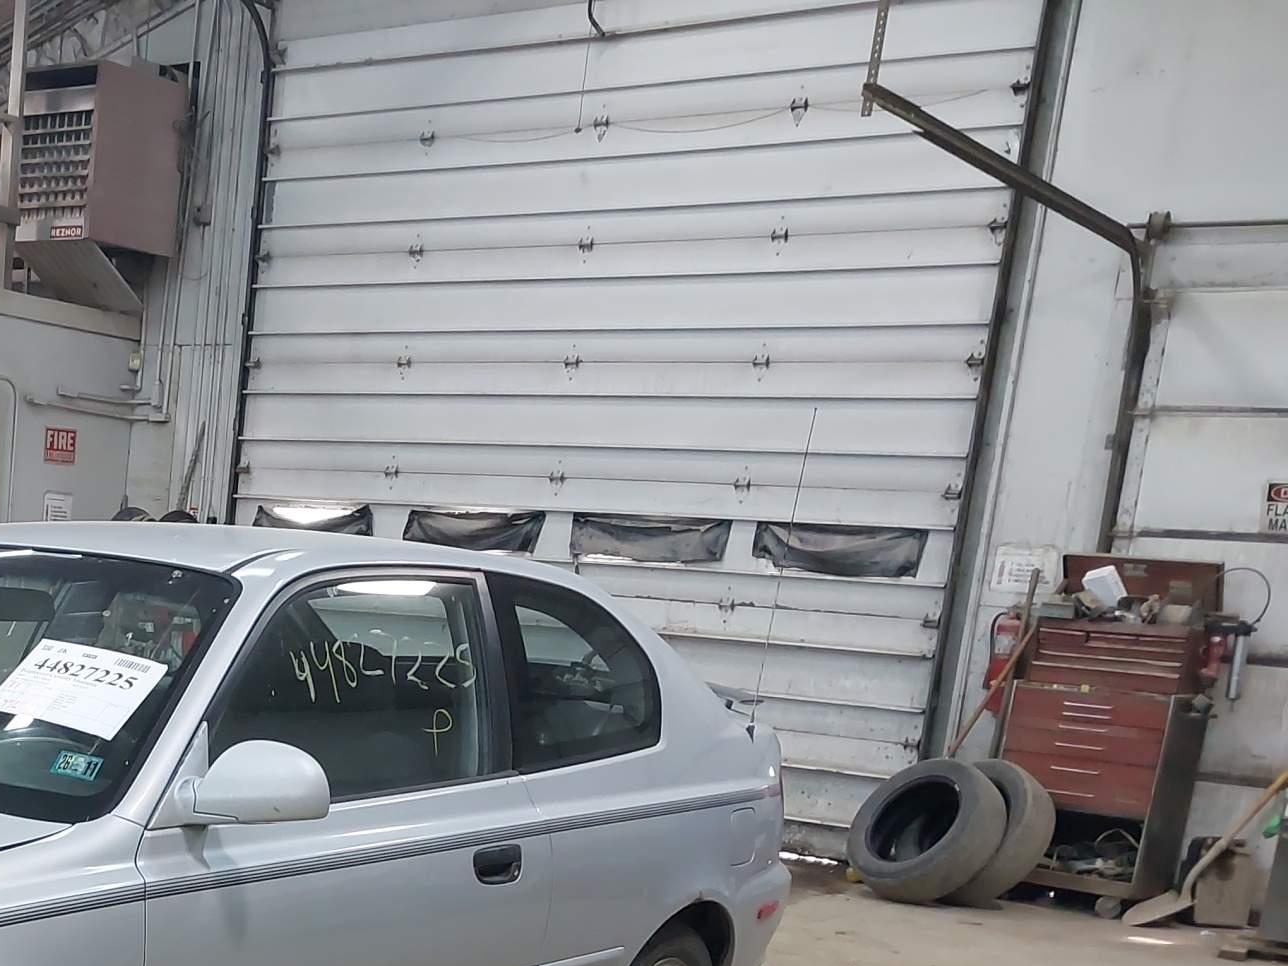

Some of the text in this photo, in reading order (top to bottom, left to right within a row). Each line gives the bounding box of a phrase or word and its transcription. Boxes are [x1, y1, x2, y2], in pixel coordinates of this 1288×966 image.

[46, 430, 75, 450] FIRE
[34, 658, 138, 690] 44827225
[423, 708, 452, 756] P
[83, 760, 99, 777] 11
